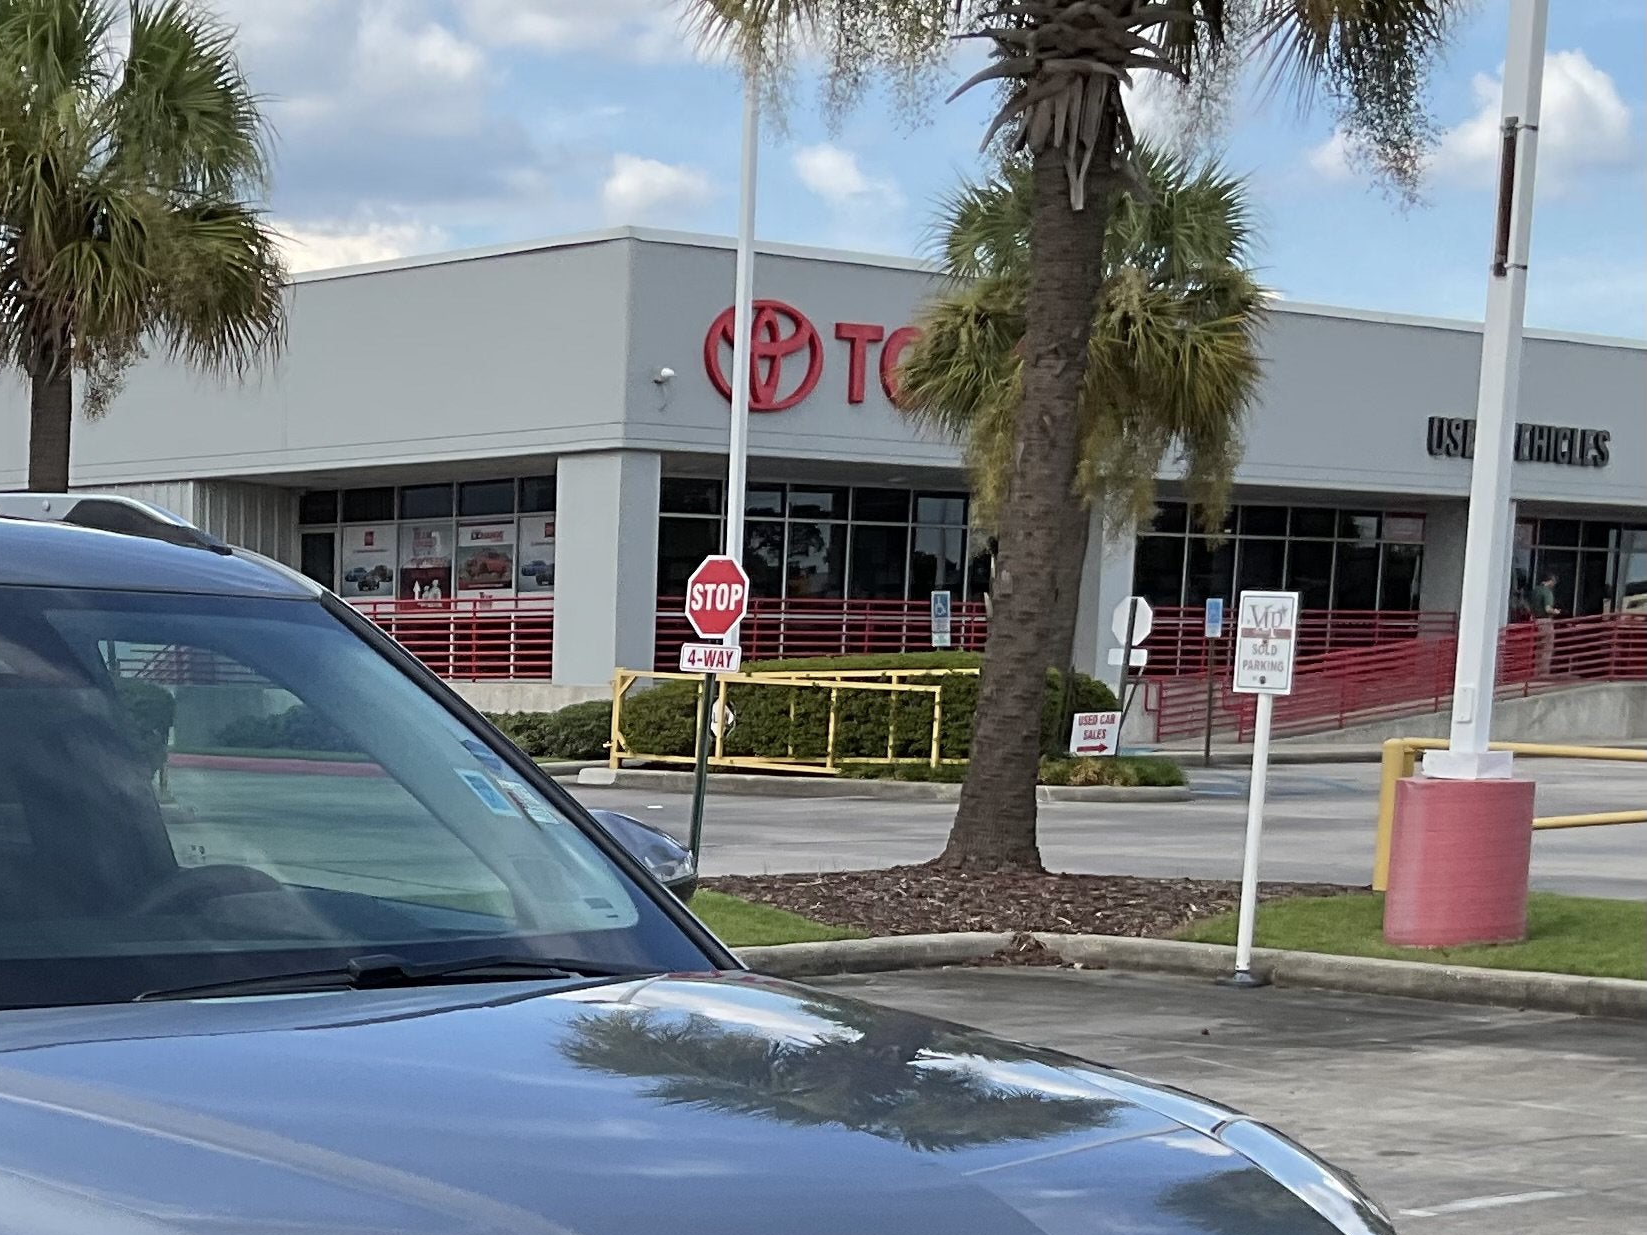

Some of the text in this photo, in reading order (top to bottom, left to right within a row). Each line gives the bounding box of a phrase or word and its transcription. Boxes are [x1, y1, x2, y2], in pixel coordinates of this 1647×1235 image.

[1514, 422, 1611, 467] EHICLES
[690, 583, 744, 611] STOP
[1252, 643, 1278, 656] SOLD
[687, 649, 734, 669] 4-WAY
[1242, 659, 1284, 672] PARKING
[1078, 713, 1116, 726] USED CAR
[1083, 728, 1107, 740] SALES
